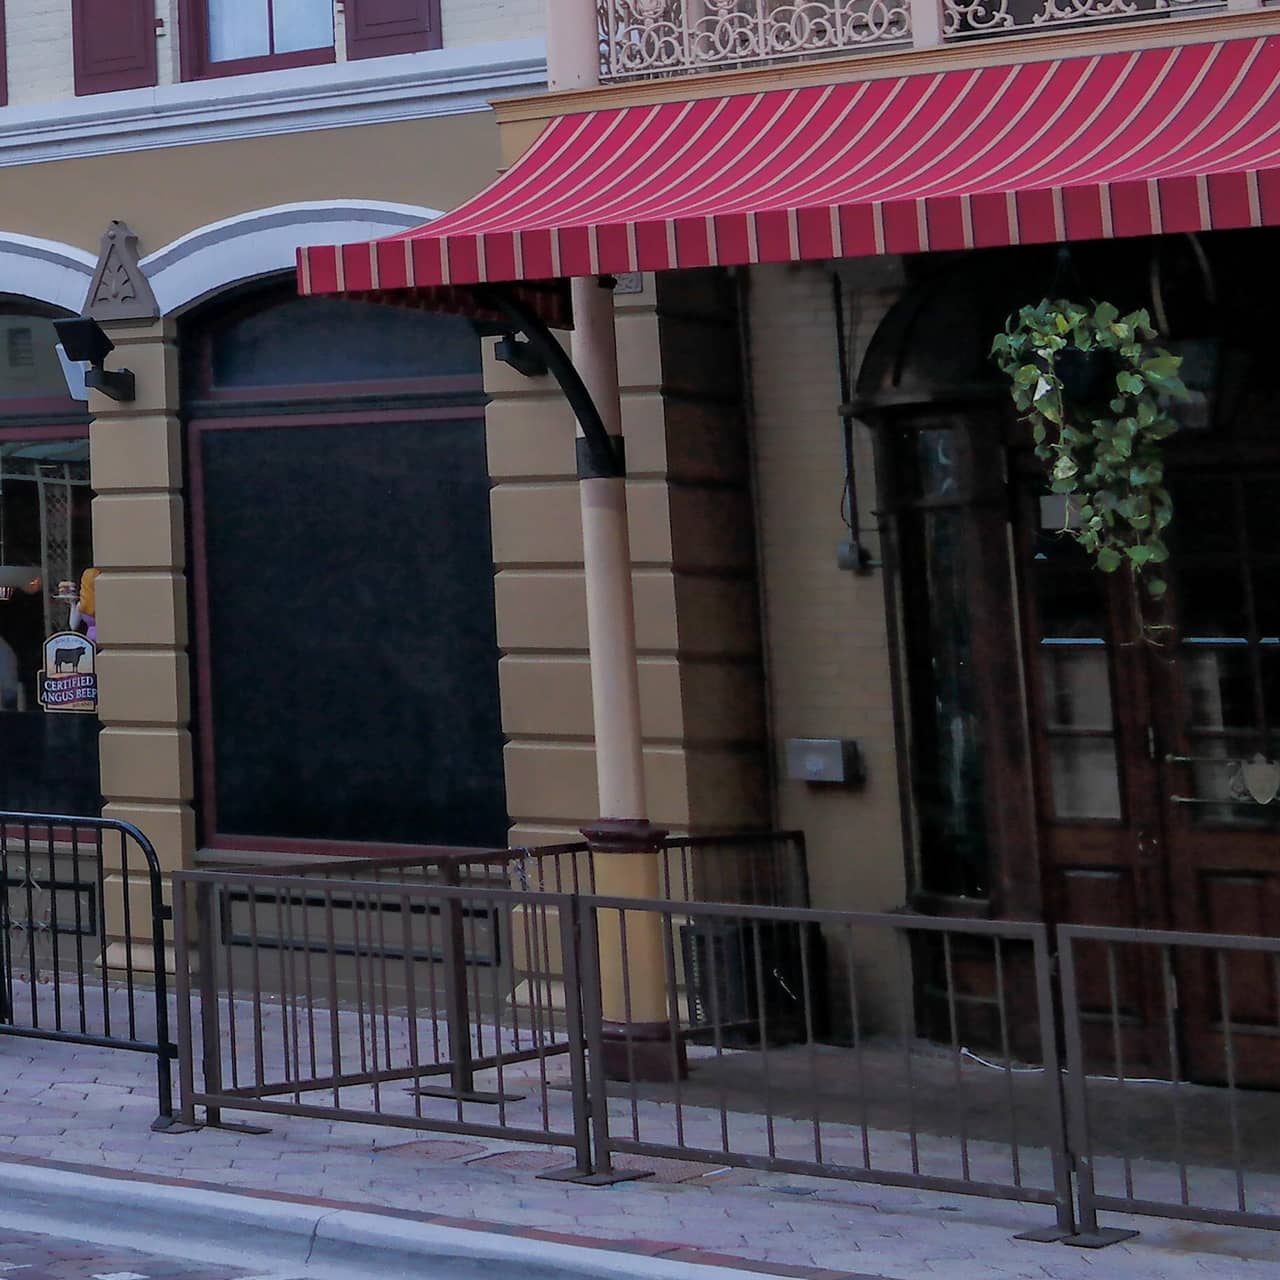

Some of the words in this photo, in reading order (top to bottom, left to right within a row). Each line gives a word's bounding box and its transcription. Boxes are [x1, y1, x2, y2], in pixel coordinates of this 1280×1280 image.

[44, 676, 94, 692] CERTIFIED
[41, 689, 74, 703] ANGUS
[75, 687, 97, 700] BEEF
